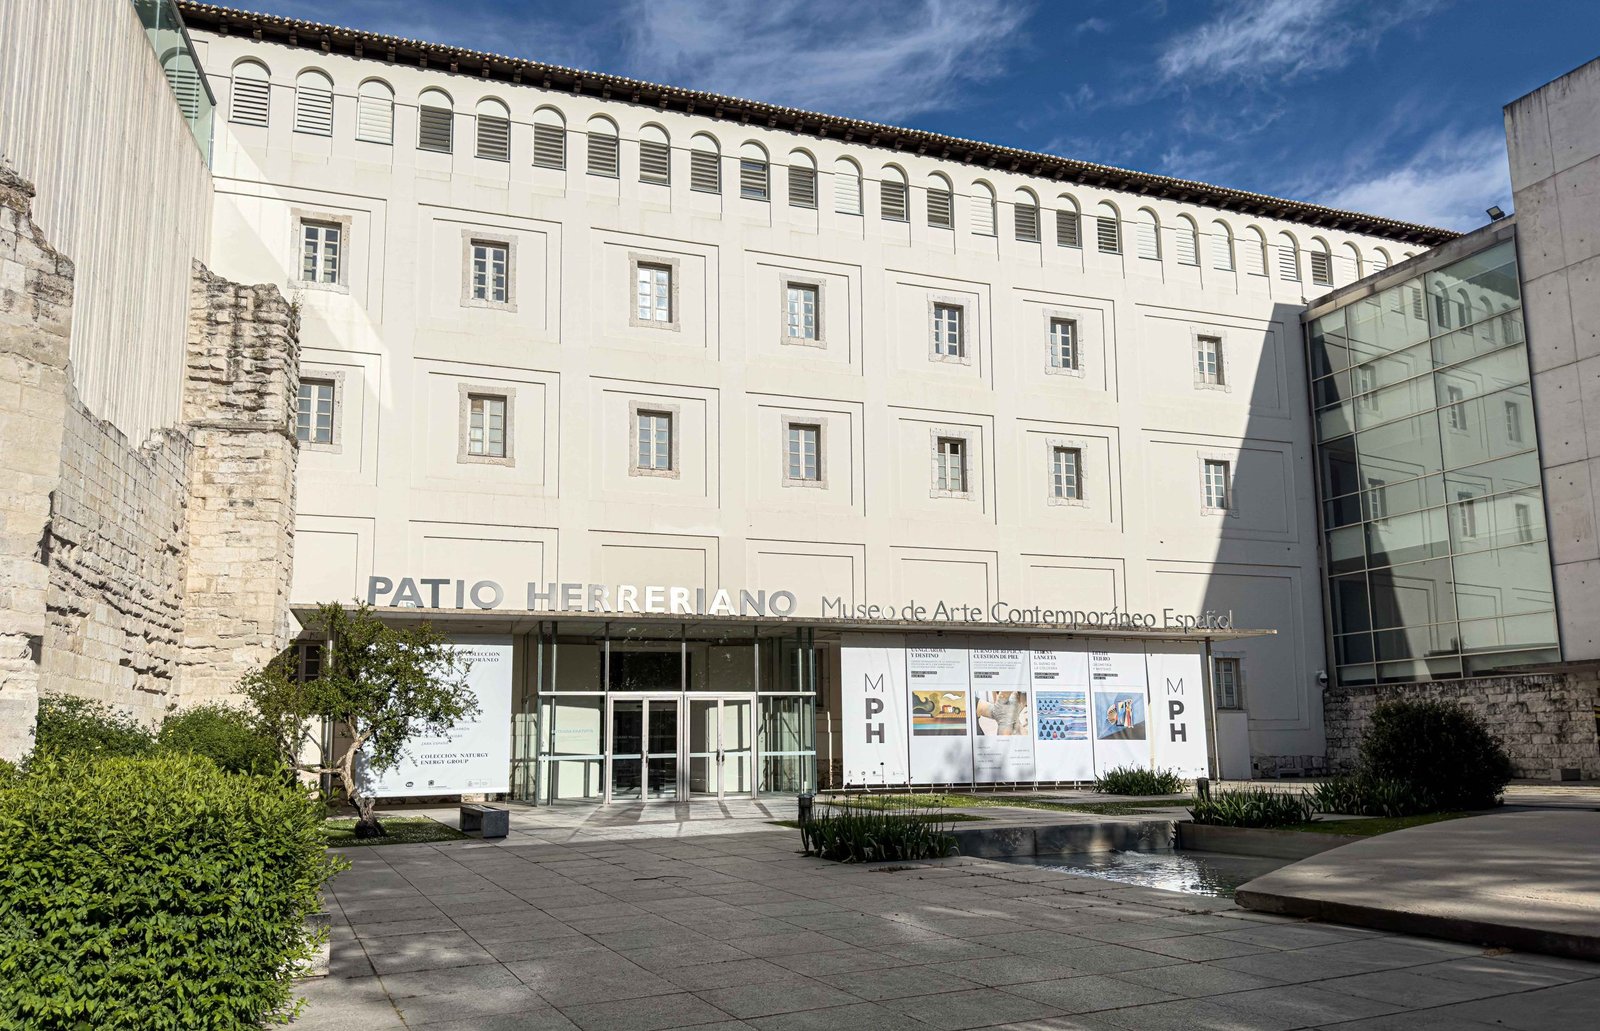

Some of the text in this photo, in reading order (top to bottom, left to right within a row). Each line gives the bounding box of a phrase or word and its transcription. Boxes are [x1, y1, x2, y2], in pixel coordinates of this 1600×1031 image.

[367, 575, 1233, 634] PATIO HERRERIANO Museo de Arte Contemporáneo Español
